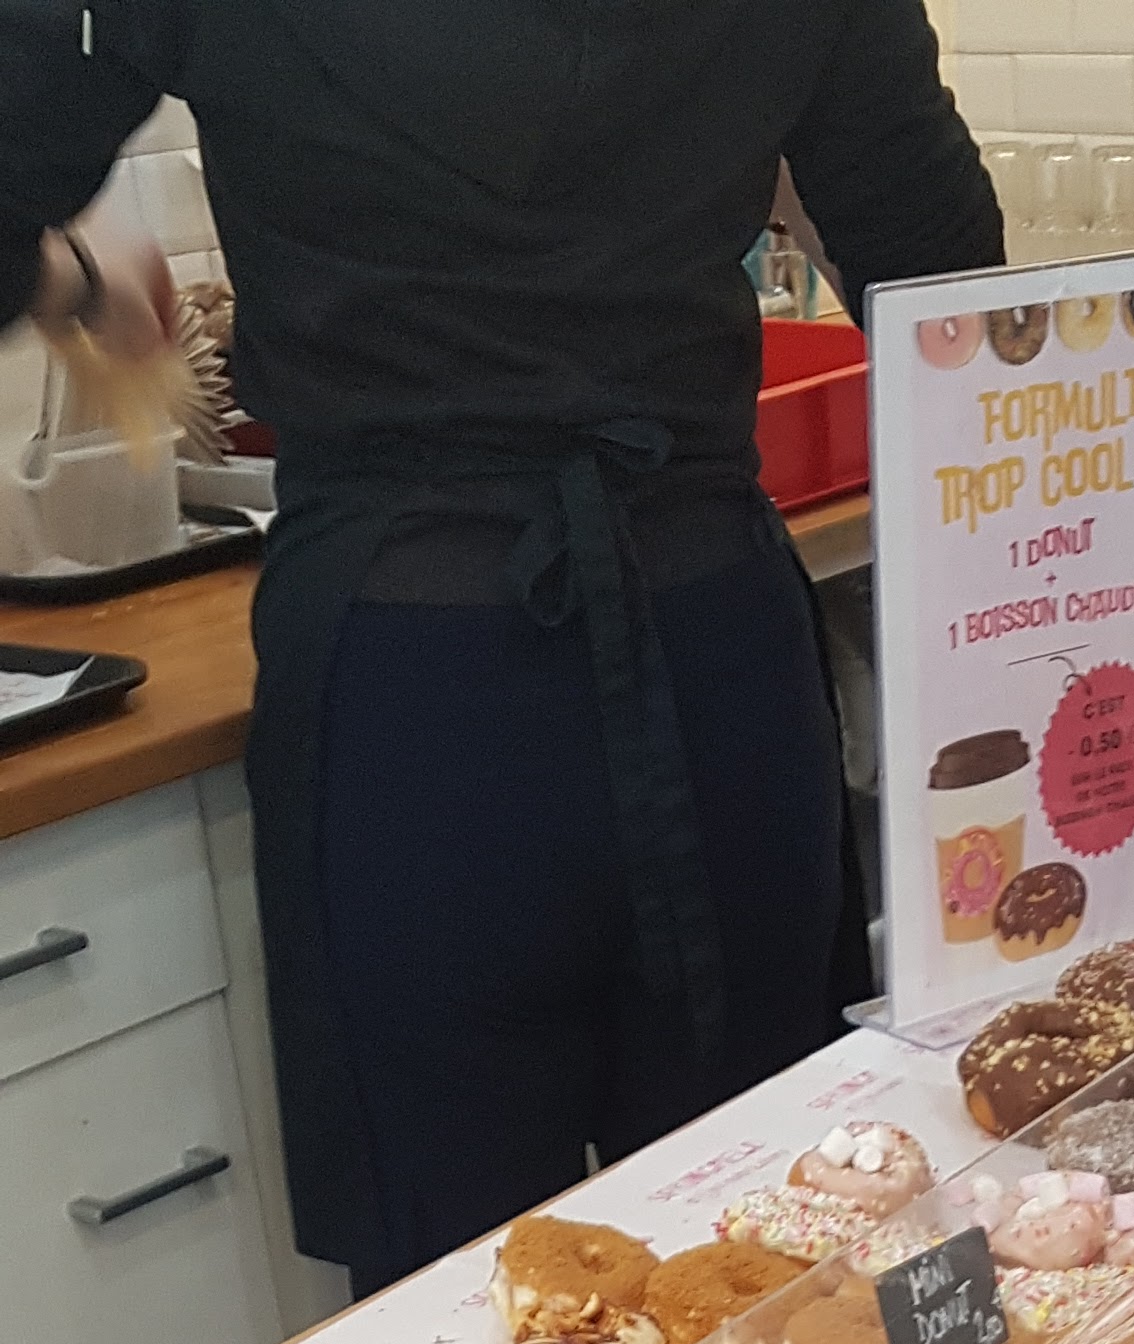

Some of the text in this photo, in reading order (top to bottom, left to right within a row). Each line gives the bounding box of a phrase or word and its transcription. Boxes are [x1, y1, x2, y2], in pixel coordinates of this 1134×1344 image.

[934, 455, 1026, 534] TROP
[1040, 436, 1134, 507] COOL
[1009, 516, 1096, 568] 1 DONUT
[948, 621, 958, 651] 1
[964, 595, 1059, 644] BOISSON
